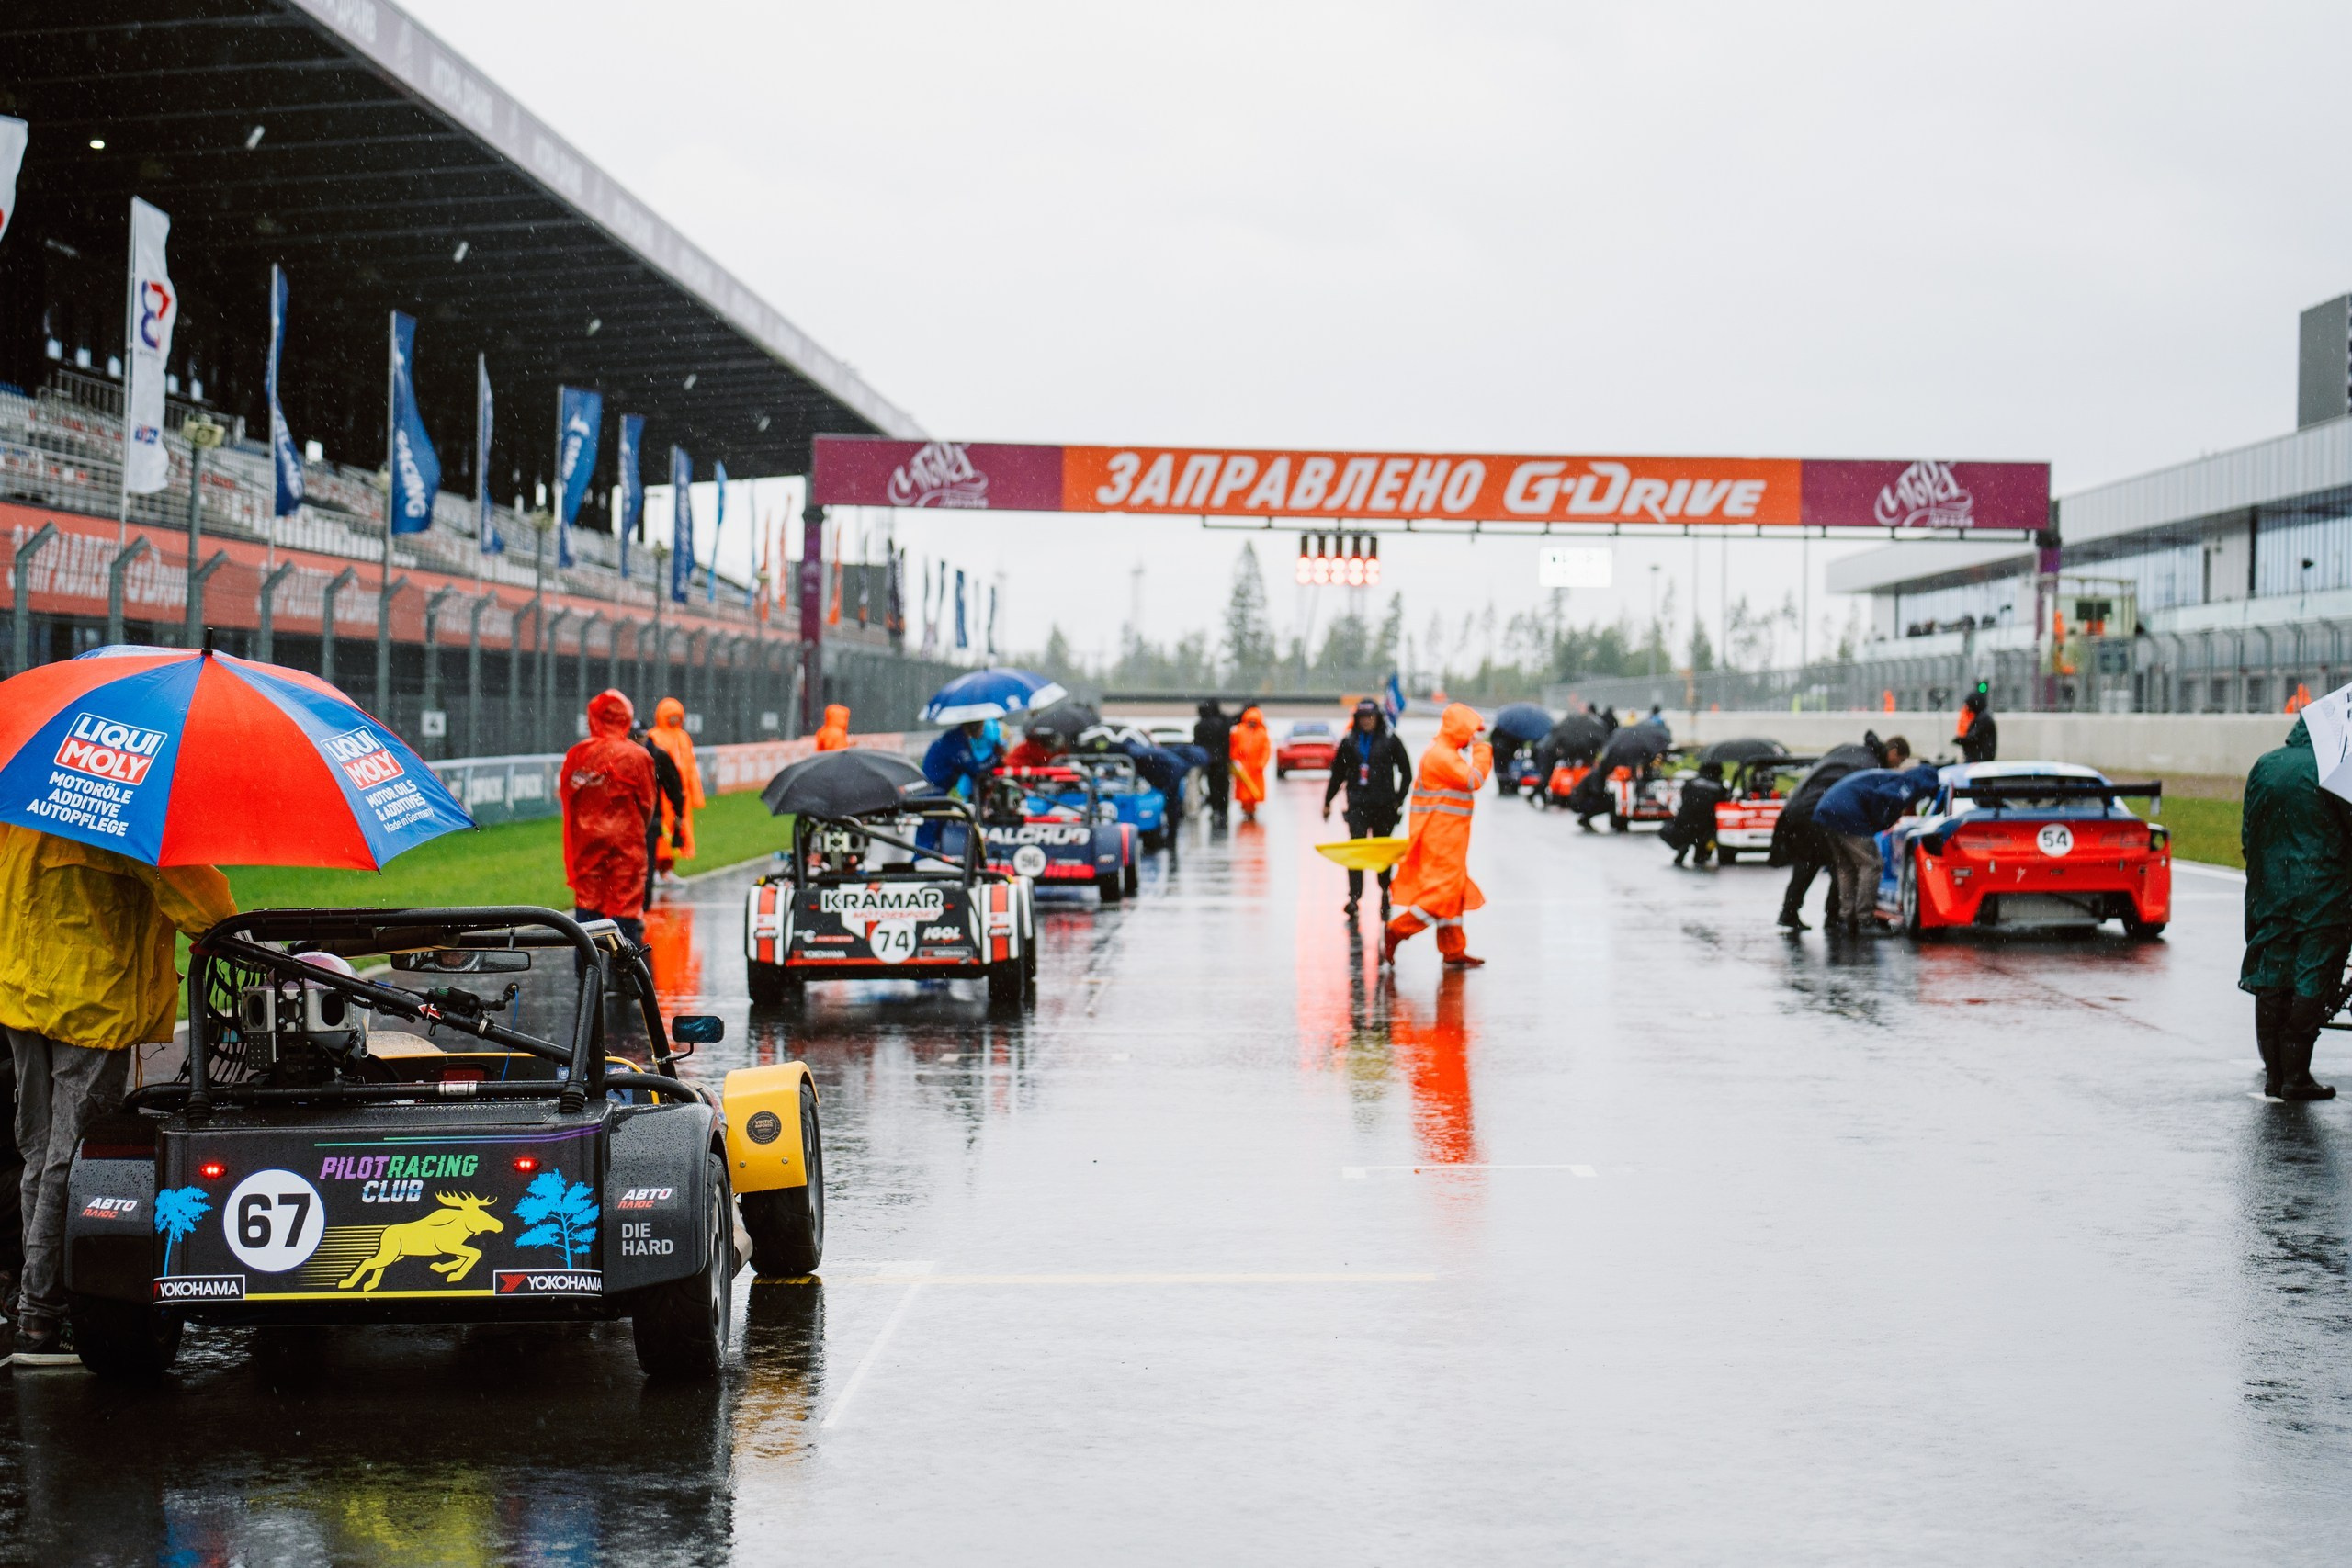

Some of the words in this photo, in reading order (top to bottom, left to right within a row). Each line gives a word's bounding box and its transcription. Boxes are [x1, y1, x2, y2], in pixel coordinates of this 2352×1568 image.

[1096, 452, 1487, 513] ЗАПРАВЛЕНО
[74, 716, 162, 755] LIQUI
[325, 730, 380, 762] LIQUI
[61, 739, 151, 780] MOLY
[345, 751, 397, 786] MOLY
[49, 771, 134, 805] MOTORÖLE
[365, 787, 398, 808] MOTOR
[394, 779, 417, 796] OILS
[48, 788, 121, 818] ADDITIVE
[27, 799, 129, 837] AUTOPFLEGE
[383, 819, 402, 833] Made
[407, 807, 435, 824] Germany
[2042, 830, 2068, 846] 54
[824, 892, 940, 908] KRAMAR
[877, 930, 910, 952] 74
[922, 926, 961, 941] IGOL
[362, 1179, 424, 1203] CLUB
[621, 1188, 673, 1200] АВТО
[82, 1207, 119, 1219] ПЛЮС
[87, 1197, 138, 1212] АВТО
[617, 1200, 655, 1209] ПЛЮС
[238, 1193, 311, 1248] 67
[622, 1223, 651, 1238] DIE
[622, 1238, 674, 1257] HARD
[160, 1281, 240, 1297] YOKOHAMA
[527, 1275, 603, 1292] YOKOHAMA
